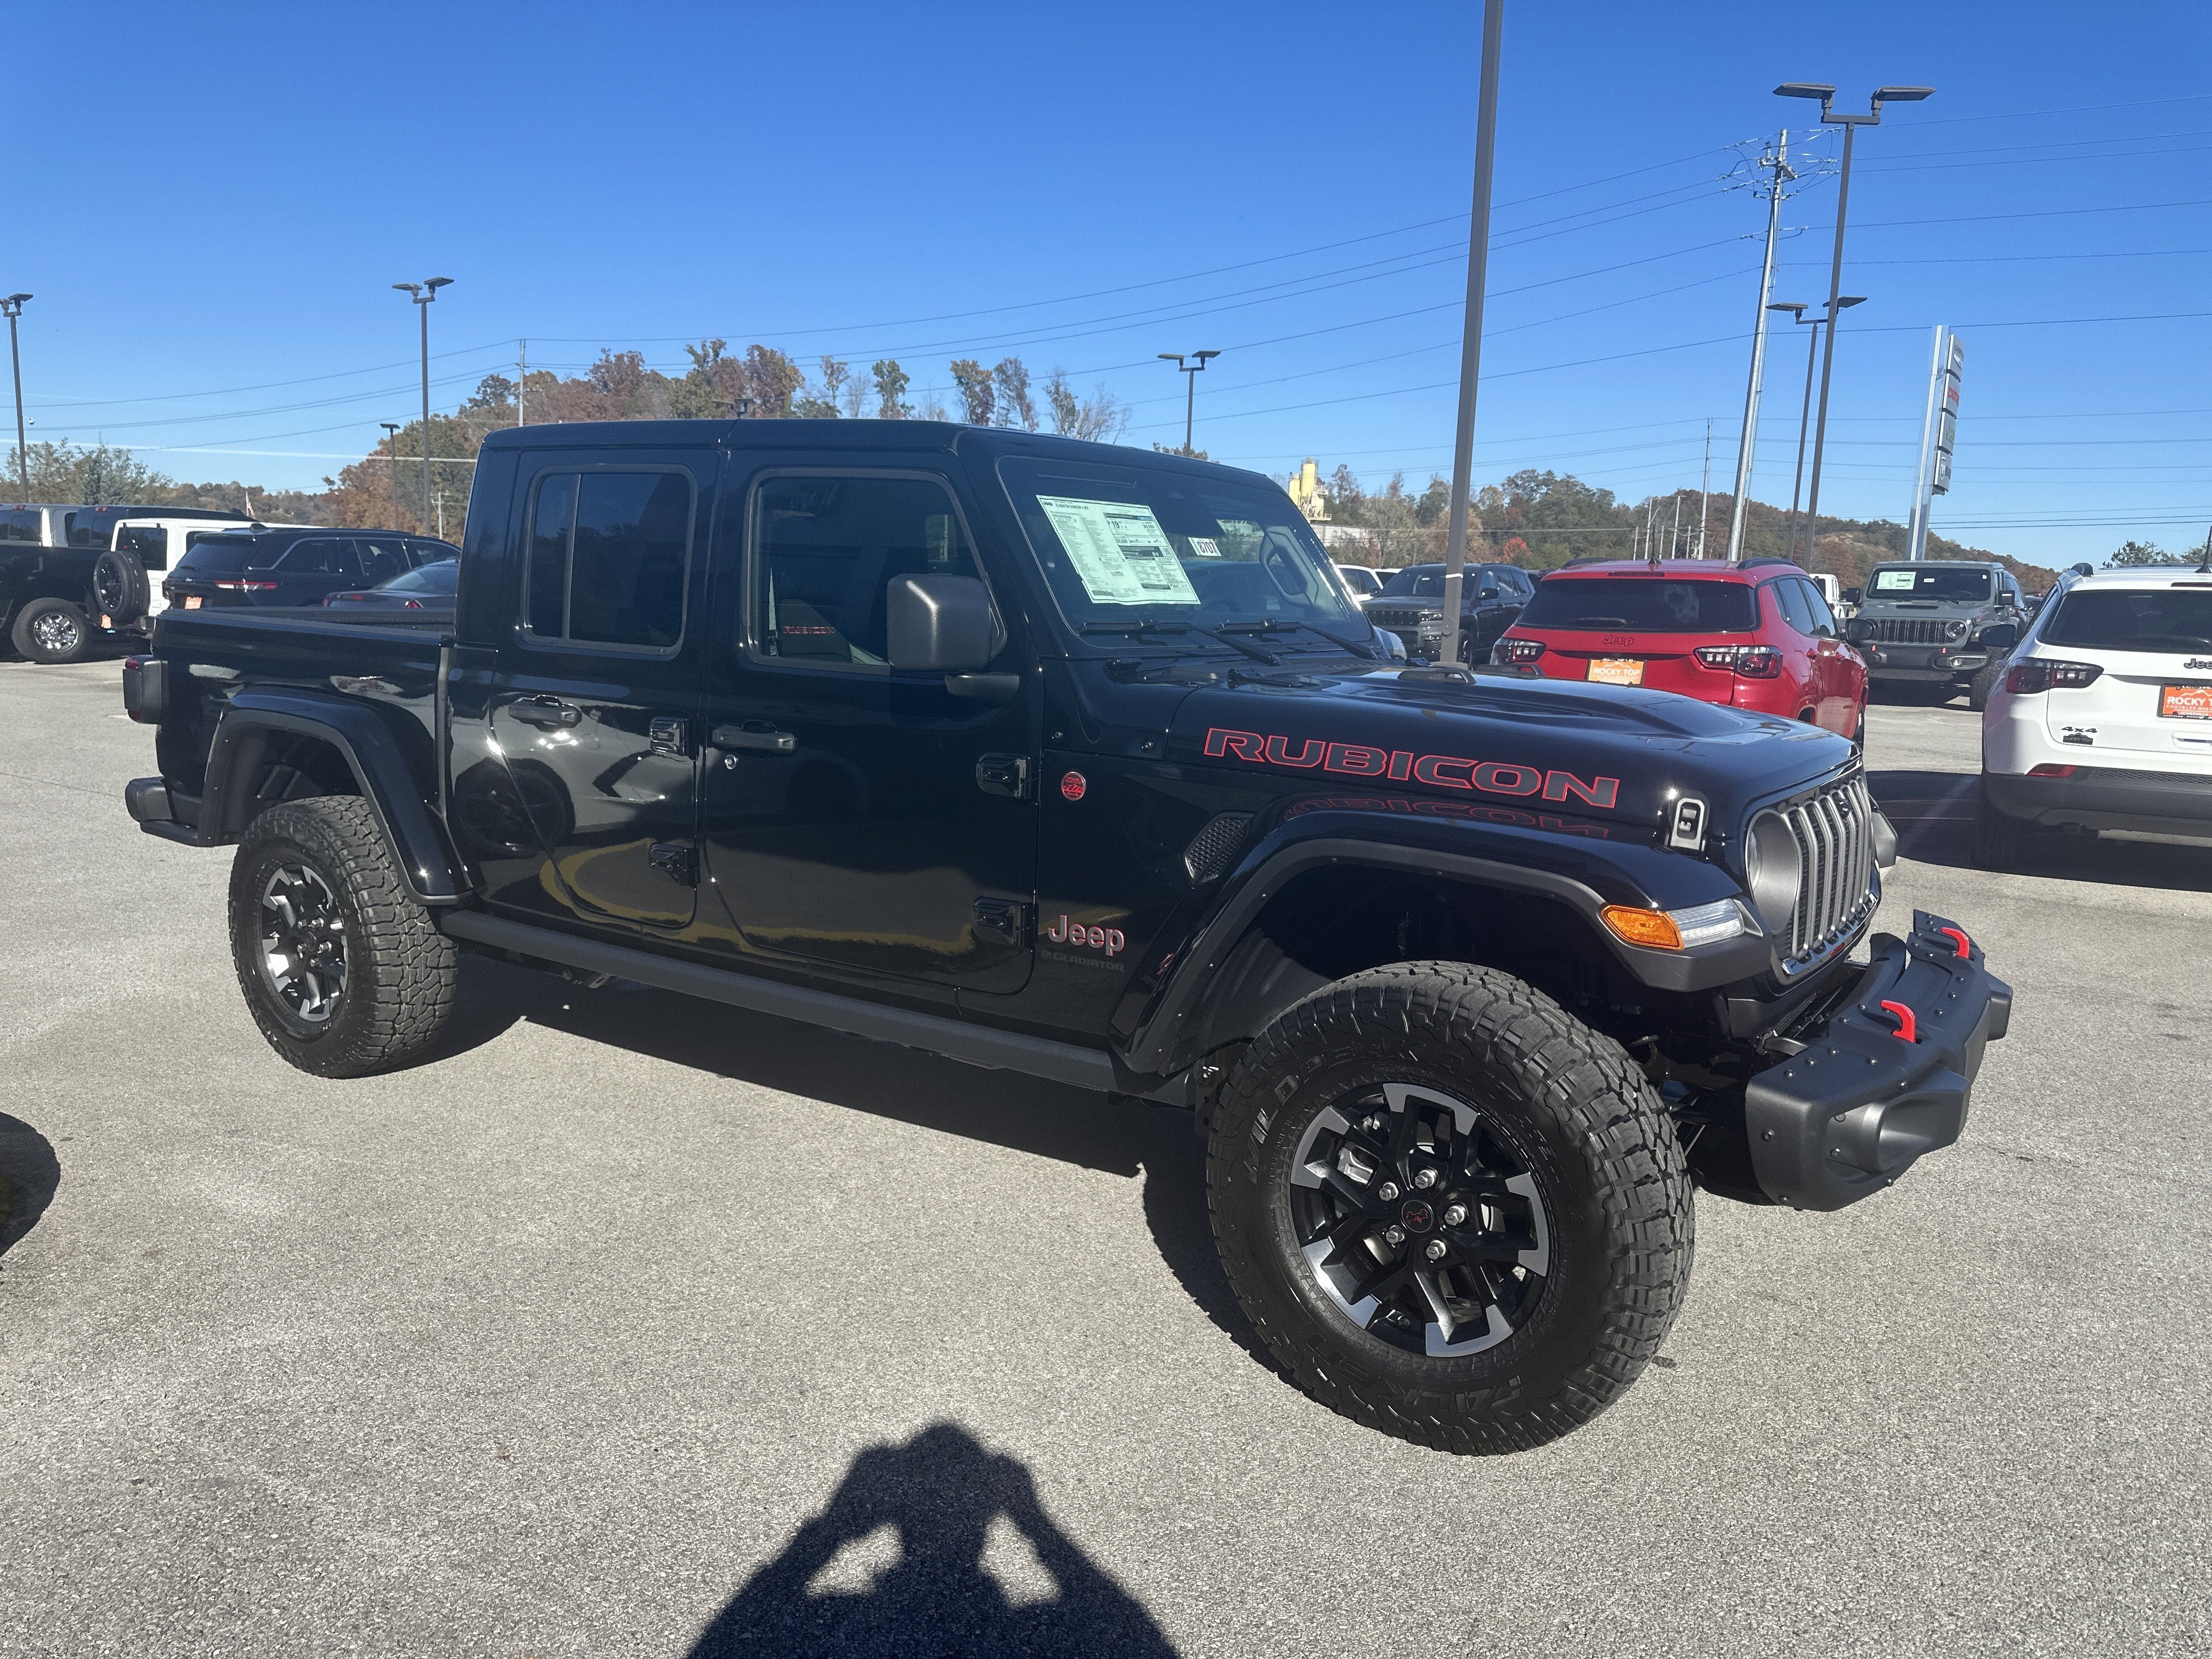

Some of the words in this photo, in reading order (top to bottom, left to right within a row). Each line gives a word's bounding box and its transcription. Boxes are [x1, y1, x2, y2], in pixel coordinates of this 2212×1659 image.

[1602, 634, 1634, 646] Jeep
[1593, 667, 1622, 675] ROCKY
[2167, 696, 2206, 706] ROCKY
[1203, 727, 1620, 809] RUBICON
[1047, 914, 1126, 957] Jeep
[1053, 952, 1126, 972] GLADIATOR
